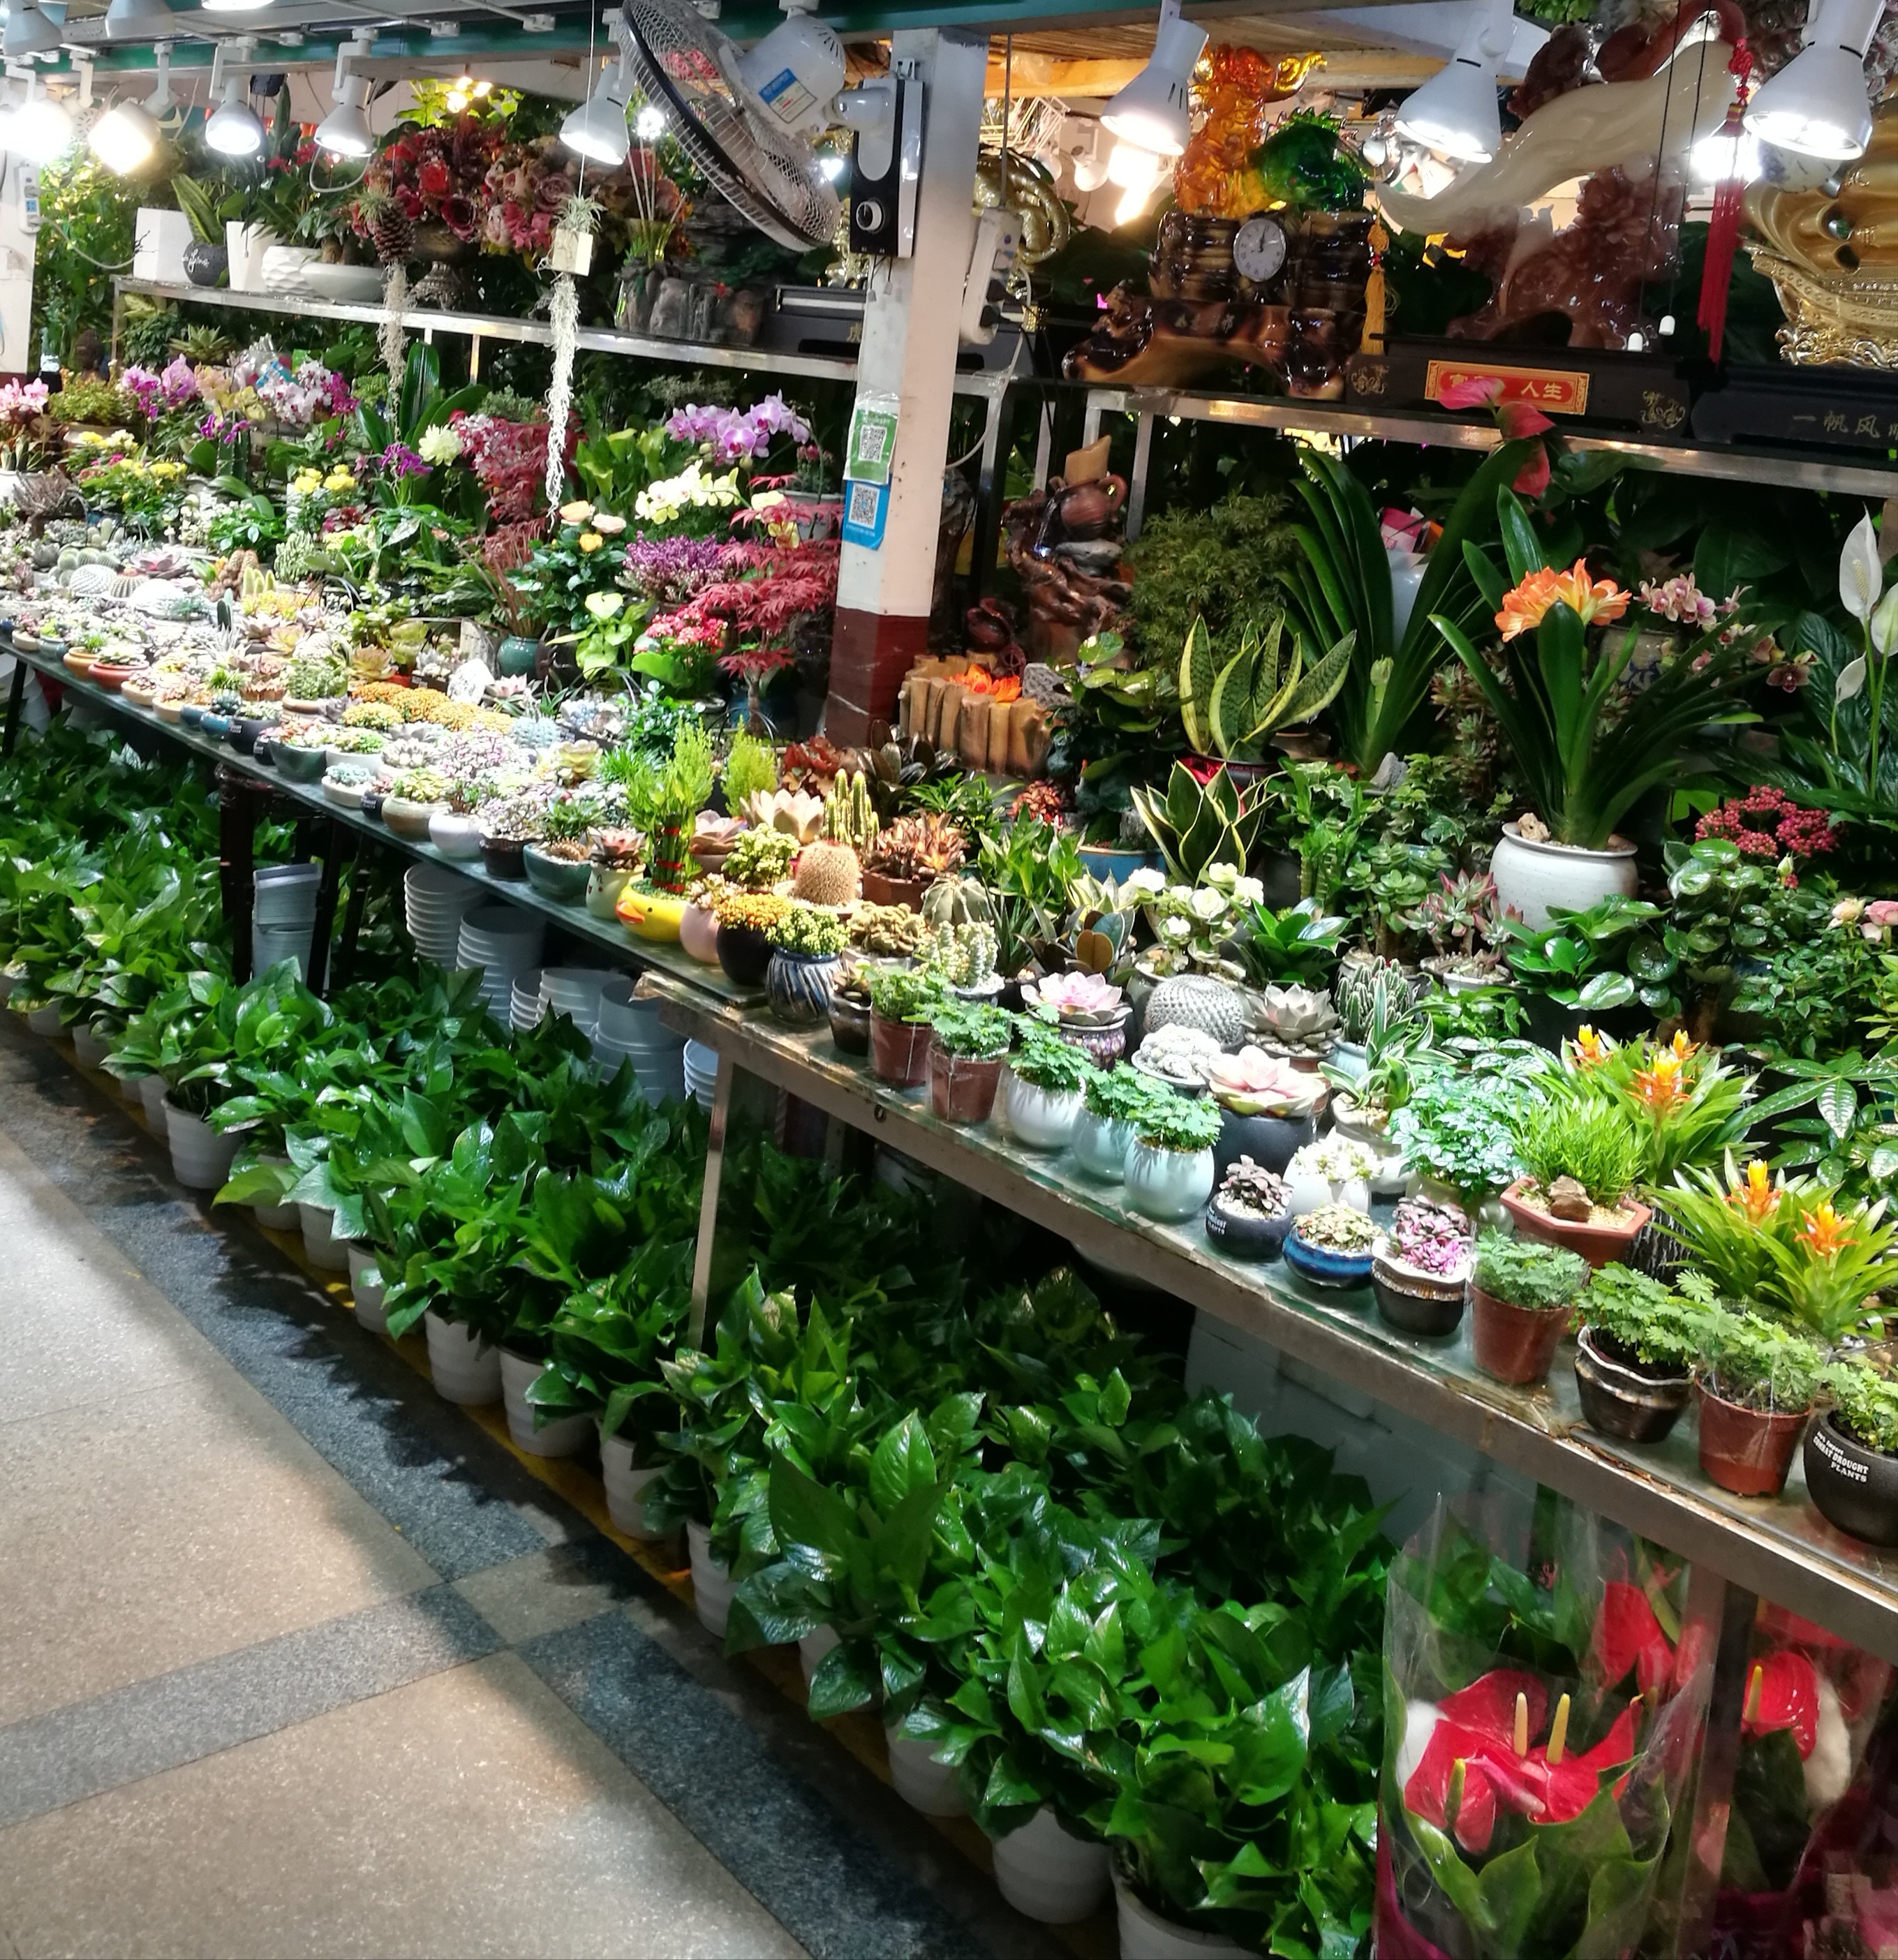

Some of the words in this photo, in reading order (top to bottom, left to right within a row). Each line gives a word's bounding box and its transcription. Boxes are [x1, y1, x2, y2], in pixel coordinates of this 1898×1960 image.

[1520, 381, 1562, 400] 人生
[1814, 1436, 1833, 1458] COMBAT
[1832, 1453, 1869, 1474] DROUGHT
[1830, 1461, 1867, 1483] PLANTS
